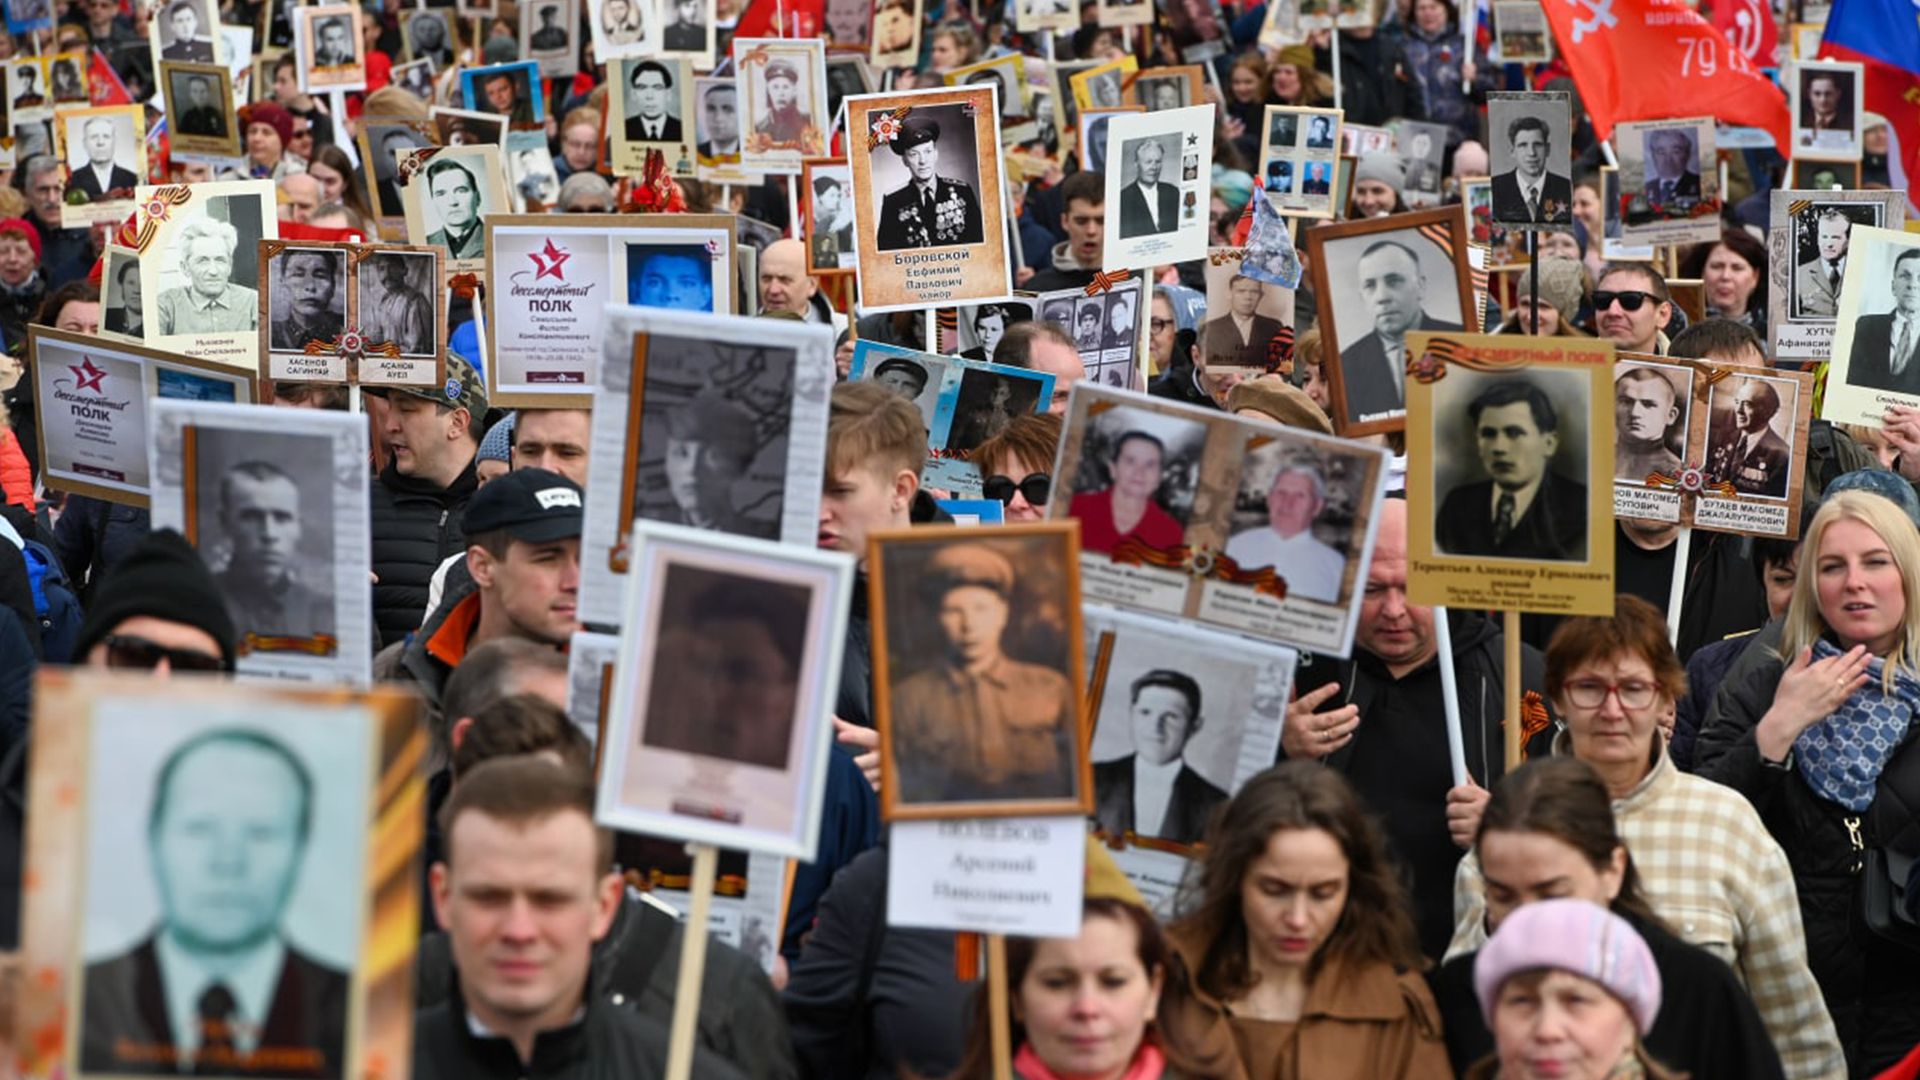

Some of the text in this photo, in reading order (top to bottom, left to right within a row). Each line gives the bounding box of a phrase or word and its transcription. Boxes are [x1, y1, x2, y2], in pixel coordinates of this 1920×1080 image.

[1677, 36, 1717, 78] 79
[894, 249, 970, 265] Боровской
[906, 264, 961, 277] Евфимий
[906, 279, 962, 290] Павлович
[529, 300, 572, 312] ПОЛК
[1778, 339, 1831, 348] Афанасий
[288, 358, 328, 367] ХАСЕНОВ
[286, 367, 329, 376] САГИНТАЙ
[71, 404, 111, 422] ПОЛК
[1634, 491, 1680, 505] МАГОМЕД
[1616, 500, 1660, 511] СУПОВИЧ
[1703, 501, 1785, 517] БУТАЕВ МАГОМЕД
[1698, 510, 1786, 526] ДЖАЛАЛУТИНОВИЧ
